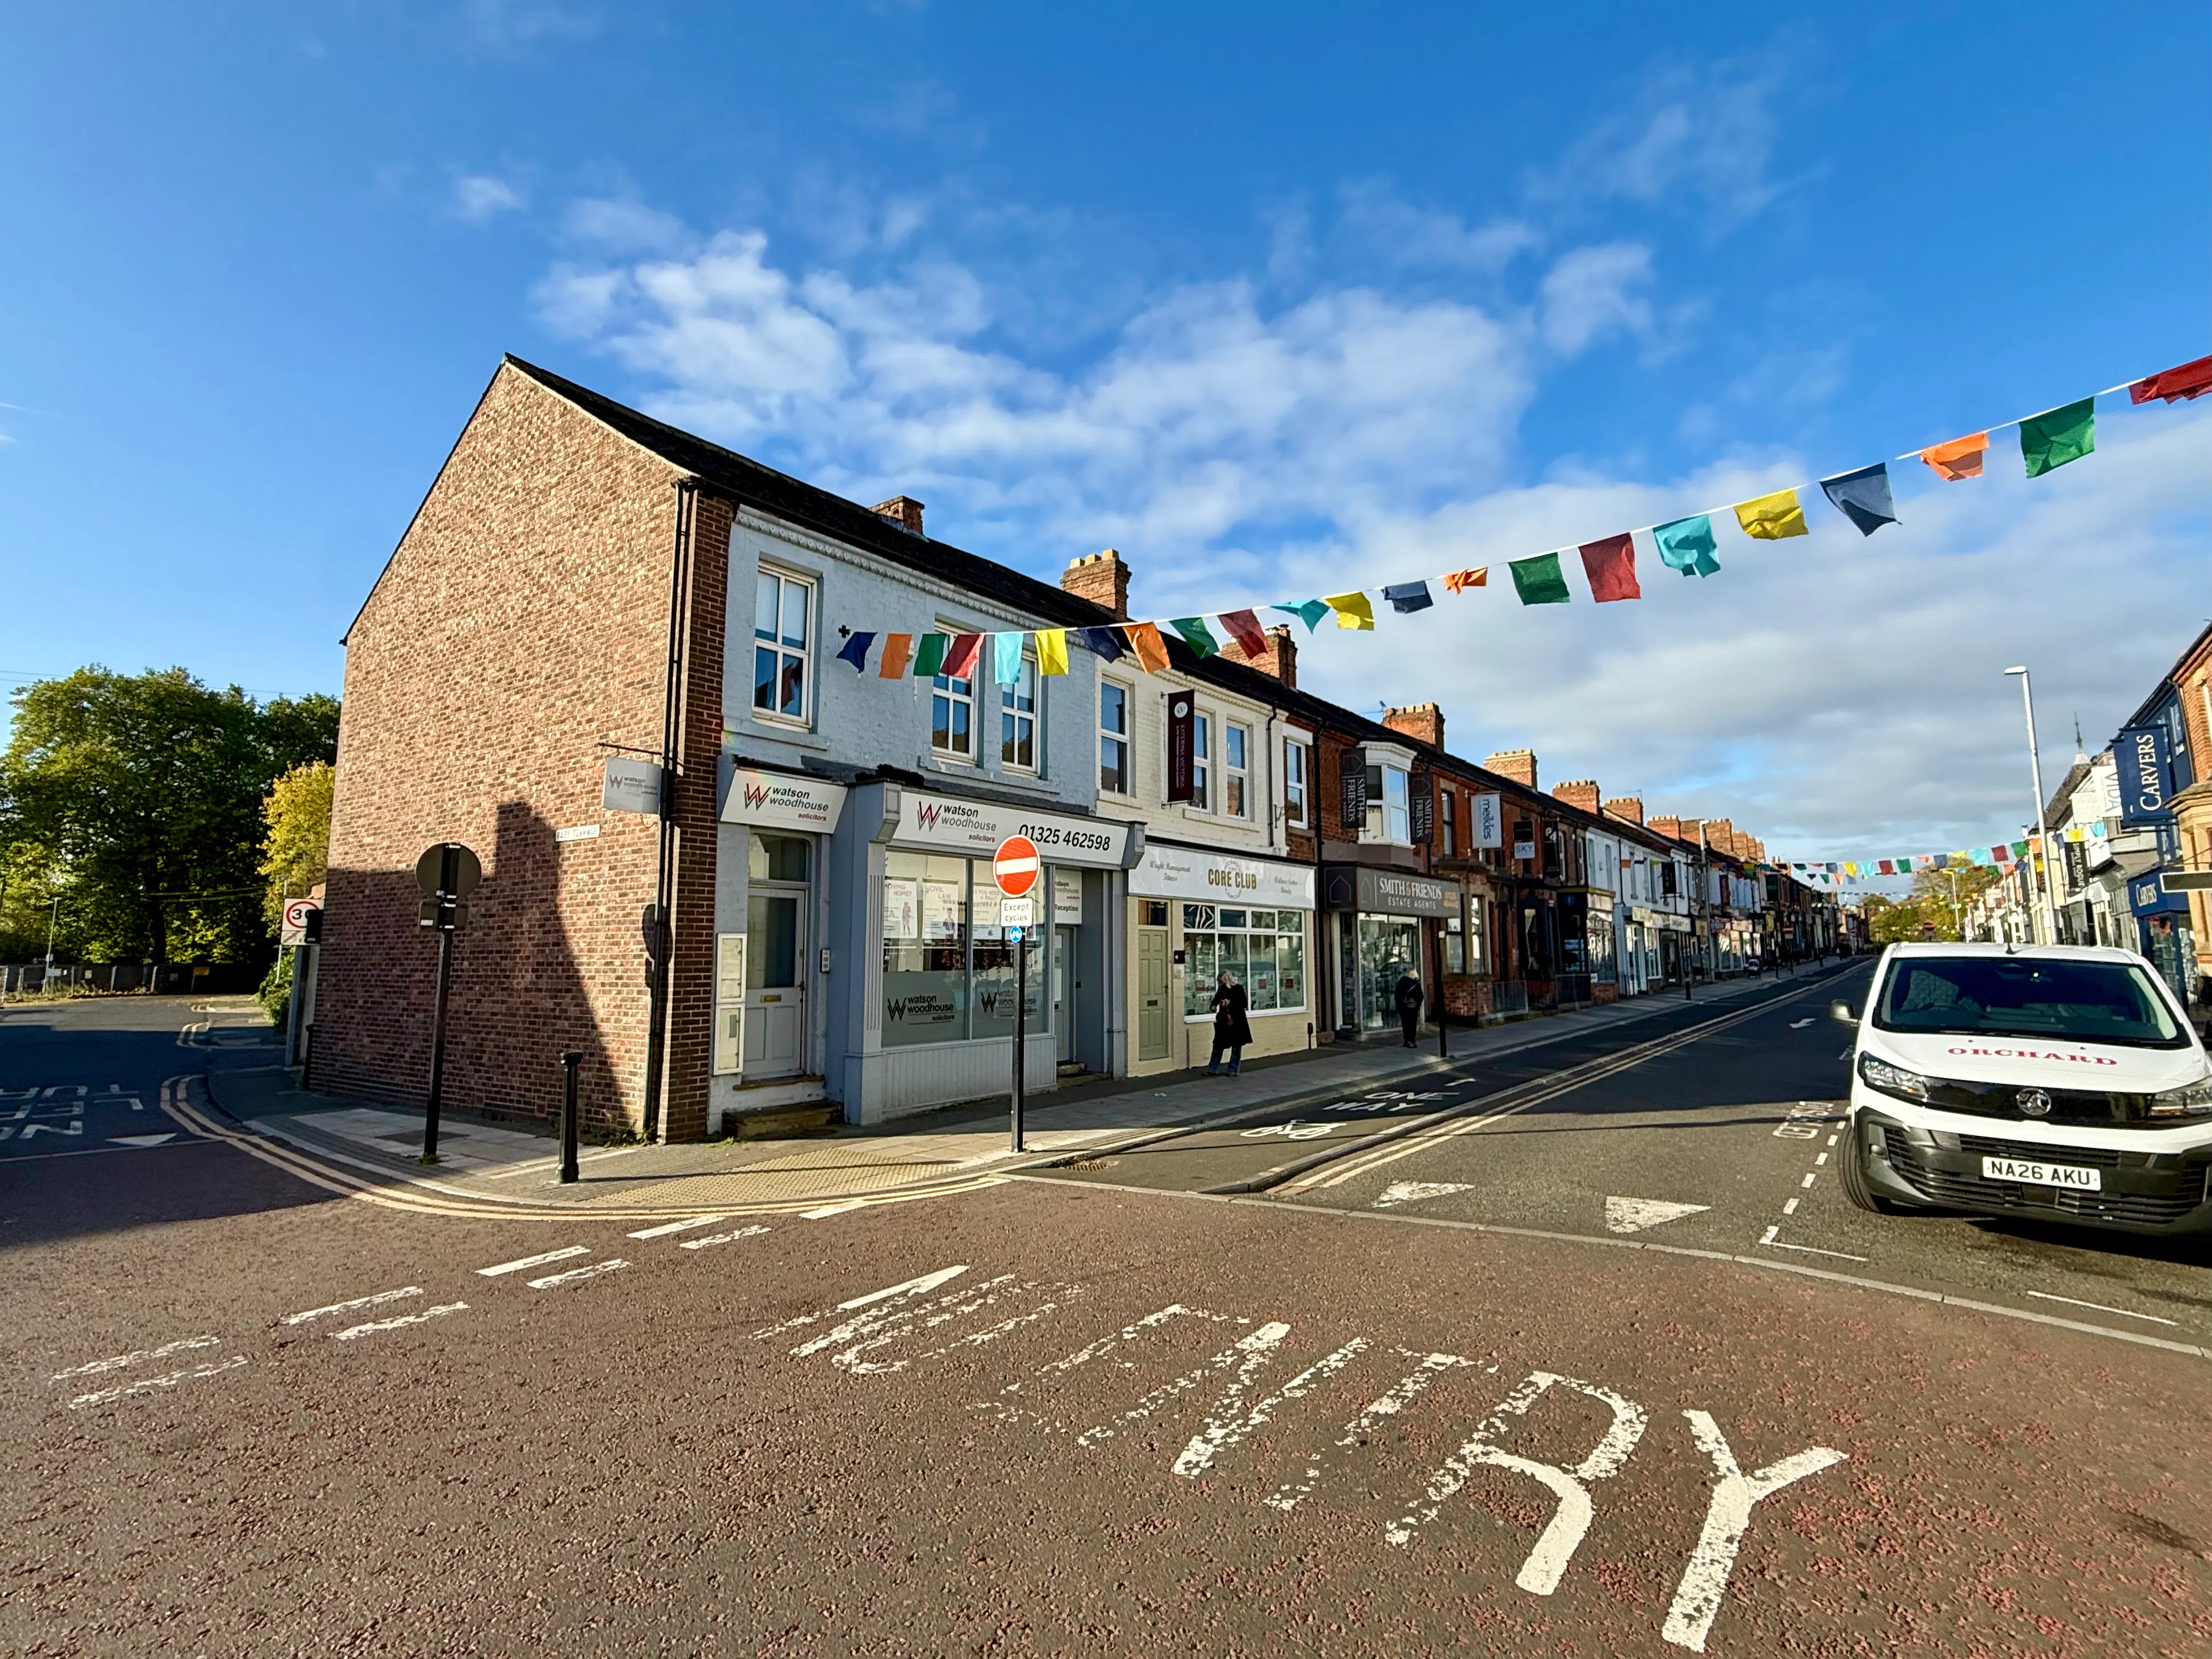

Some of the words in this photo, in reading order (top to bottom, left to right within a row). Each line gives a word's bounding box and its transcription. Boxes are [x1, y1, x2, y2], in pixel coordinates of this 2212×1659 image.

[2136, 734, 2162, 811] CARVERS
[773, 787, 810, 799] watson
[1357, 778, 1365, 810] SMITH
[2105, 772, 2121, 812] VIDA
[770, 797, 829, 811] woodhouse
[1348, 779, 1356, 822] FRIENDS
[798, 813, 827, 821] solicitors
[944, 804, 979, 817] watson
[1424, 799, 1432, 827] SMITH
[941, 816, 996, 831] woodhouse
[1483, 799, 1495, 840] meikles
[968, 834, 995, 843] solicitors
[1019, 824, 1061, 844] 01325
[1063, 831, 1110, 851] 462598
[1516, 845, 1533, 853] SKY
[1208, 868, 1232, 887] CORE
[1235, 872, 1257, 889] CLUB
[1380, 878, 1405, 895] SMITH
[1412, 883, 1441, 899] FRIENDS
[1004, 903, 1029, 912] Except
[1055, 904, 1078, 912] Reception
[1388, 896, 1411, 907] ESTATE
[1414, 900, 1436, 910] AGENTS
[1005, 914, 1028, 923] cycles
[908, 995, 937, 1004] watson
[907, 1003, 954, 1013] woodhouse
[1947, 1047, 2118, 1065] ORCHARD
[1364, 1092, 1460, 1100] ONE
[1322, 1102, 1425, 1112] WAY
[1991, 1160, 2043, 1180] NA26
[2051, 1168, 2090, 1186] AKU
